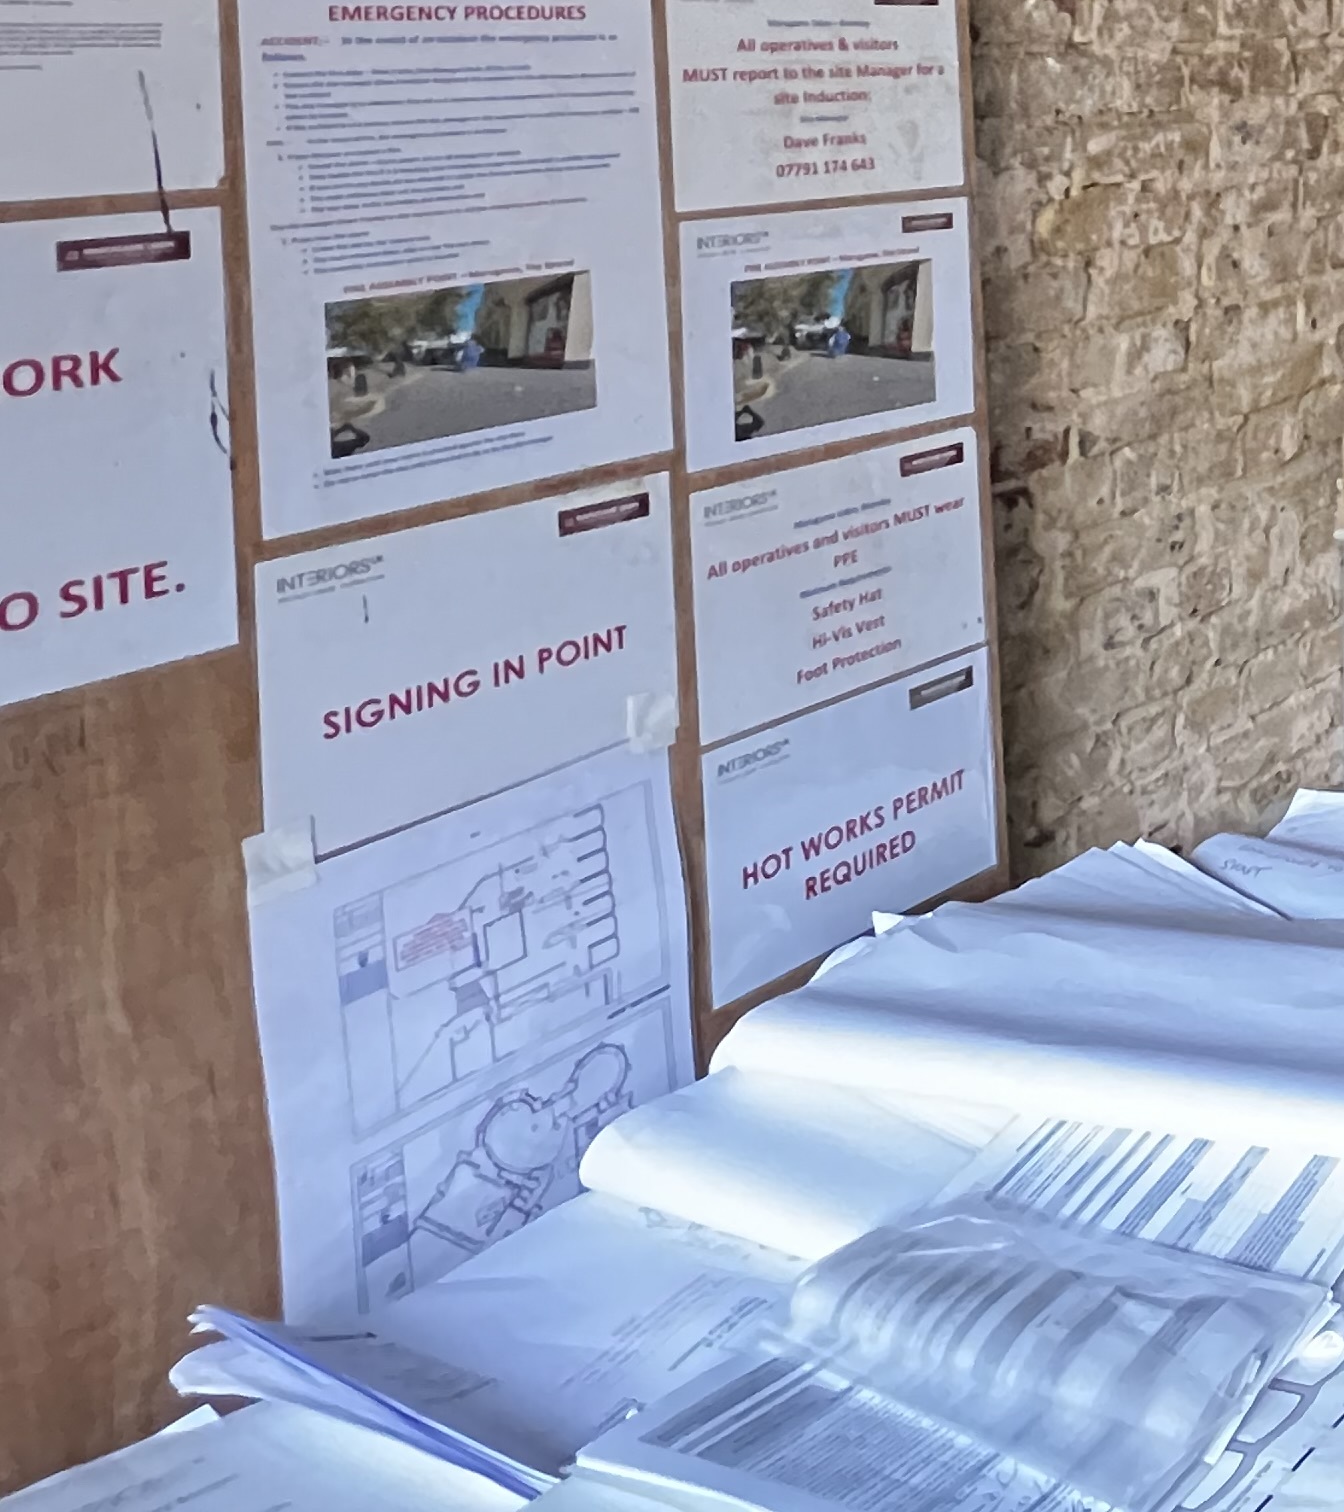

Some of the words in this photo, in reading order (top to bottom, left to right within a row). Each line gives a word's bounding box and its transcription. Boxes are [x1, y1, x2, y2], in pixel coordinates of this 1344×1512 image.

[328, 5, 458, 22] EMERGENCY
[464, 5, 587, 22] PROCEDURES
[736, 39, 756, 53] All
[760, 38, 834, 54] operatives
[838, 37, 849, 51] &
[853, 37, 899, 51] visitors
[682, 67, 729, 82] MUST
[733, 67, 779, 82] report
[783, 67, 799, 80] to
[802, 67, 824, 79] the
[829, 66, 853, 78] site
[856, 64, 913, 80] Manager
[917, 64, 934, 76] for
[773, 92, 799, 105] site
[783, 135, 819, 149] Dave
[822, 132, 867, 147] Franks
[776, 161, 819, 178] 07791
[823, 159, 848, 175] 174
[1, 347, 123, 398] ORK
[707, 563, 729, 580] All
[731, 539, 810, 573] operatives
[813, 531, 839, 550] and
[842, 519, 891, 541] visitors
[893, 504, 931, 527] MUST
[934, 497, 965, 515] wear
[833, 550, 859, 568] PPE
[0, 591, 39, 632] O
[59, 560, 186, 619] SITE.
[811, 596, 856, 621] Safety
[859, 589, 883, 606] Hat
[856, 615, 886, 635] Vest
[796, 663, 829, 685] Foot
[832, 637, 902, 671] Protection
[322, 668, 480, 740] SIGNING
[492, 654, 526, 687] IN
[537, 625, 627, 674] POINT
[742, 847, 794, 889] HOT
[800, 805, 886, 861] WORKS
[892, 769, 966, 820] PERMIT
[805, 830, 917, 899] REQUIRED
